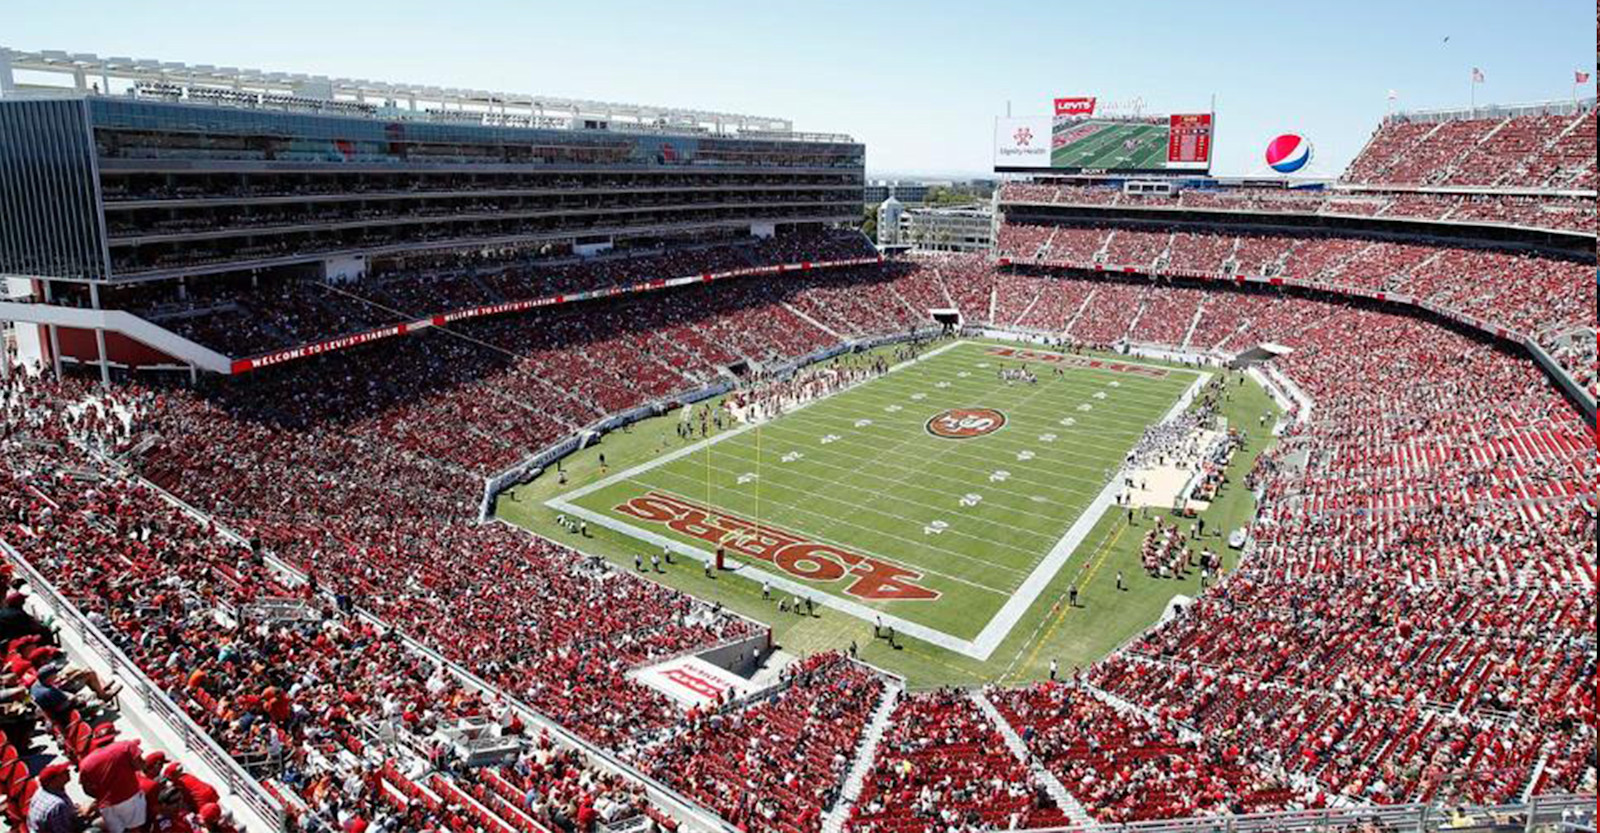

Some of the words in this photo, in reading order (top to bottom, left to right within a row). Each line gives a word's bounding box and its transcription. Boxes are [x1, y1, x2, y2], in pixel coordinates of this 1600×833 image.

[480, 306, 492, 315] TO
[251, 349, 306, 368] WELCOME
[308, 344, 321, 355] TO
[360, 326, 399, 343] STADIUM
[612, 489, 943, 600] 49ERS
